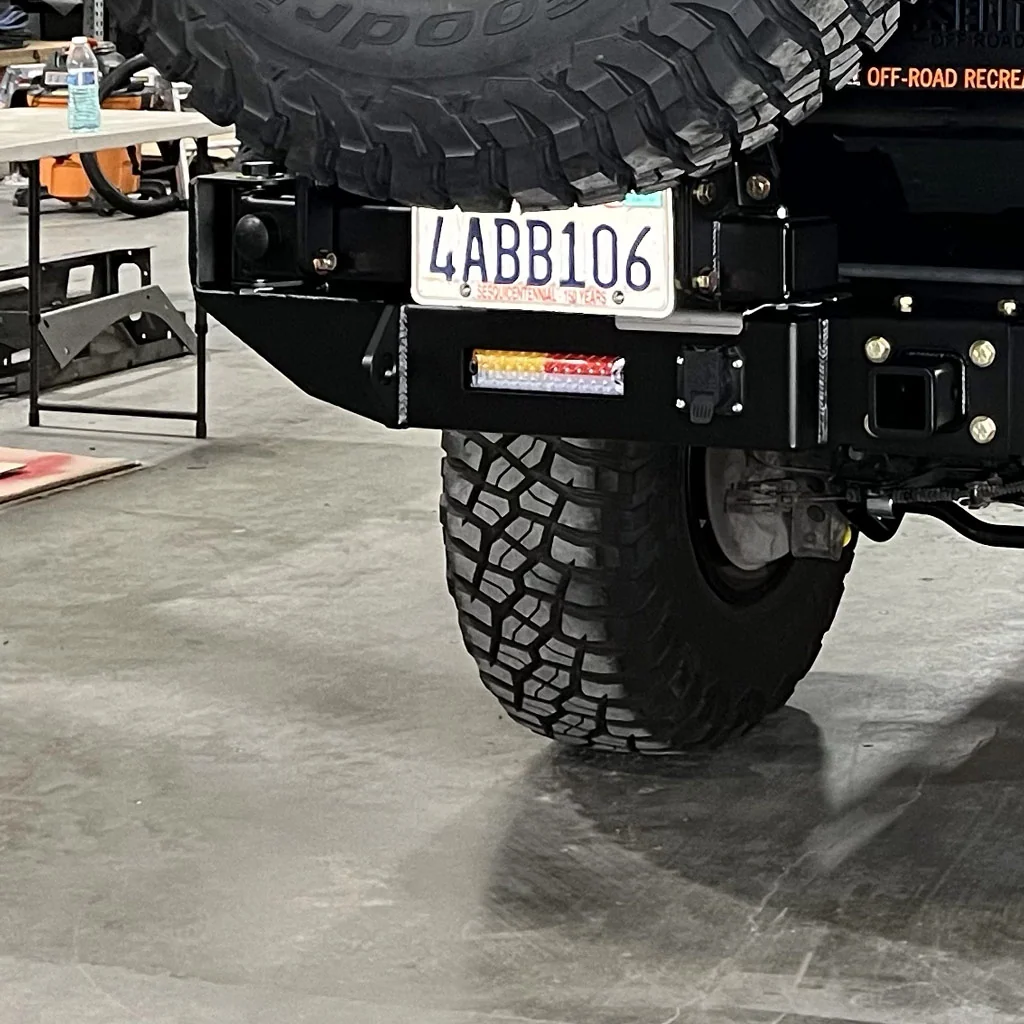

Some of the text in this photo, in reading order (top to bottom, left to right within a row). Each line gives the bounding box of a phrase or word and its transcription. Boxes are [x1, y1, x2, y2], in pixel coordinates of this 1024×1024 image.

[866, 66, 958, 89] OFF-ROAD
[429, 215, 652, 292] 4ABB106
[579, 289, 607, 306] YEARS
